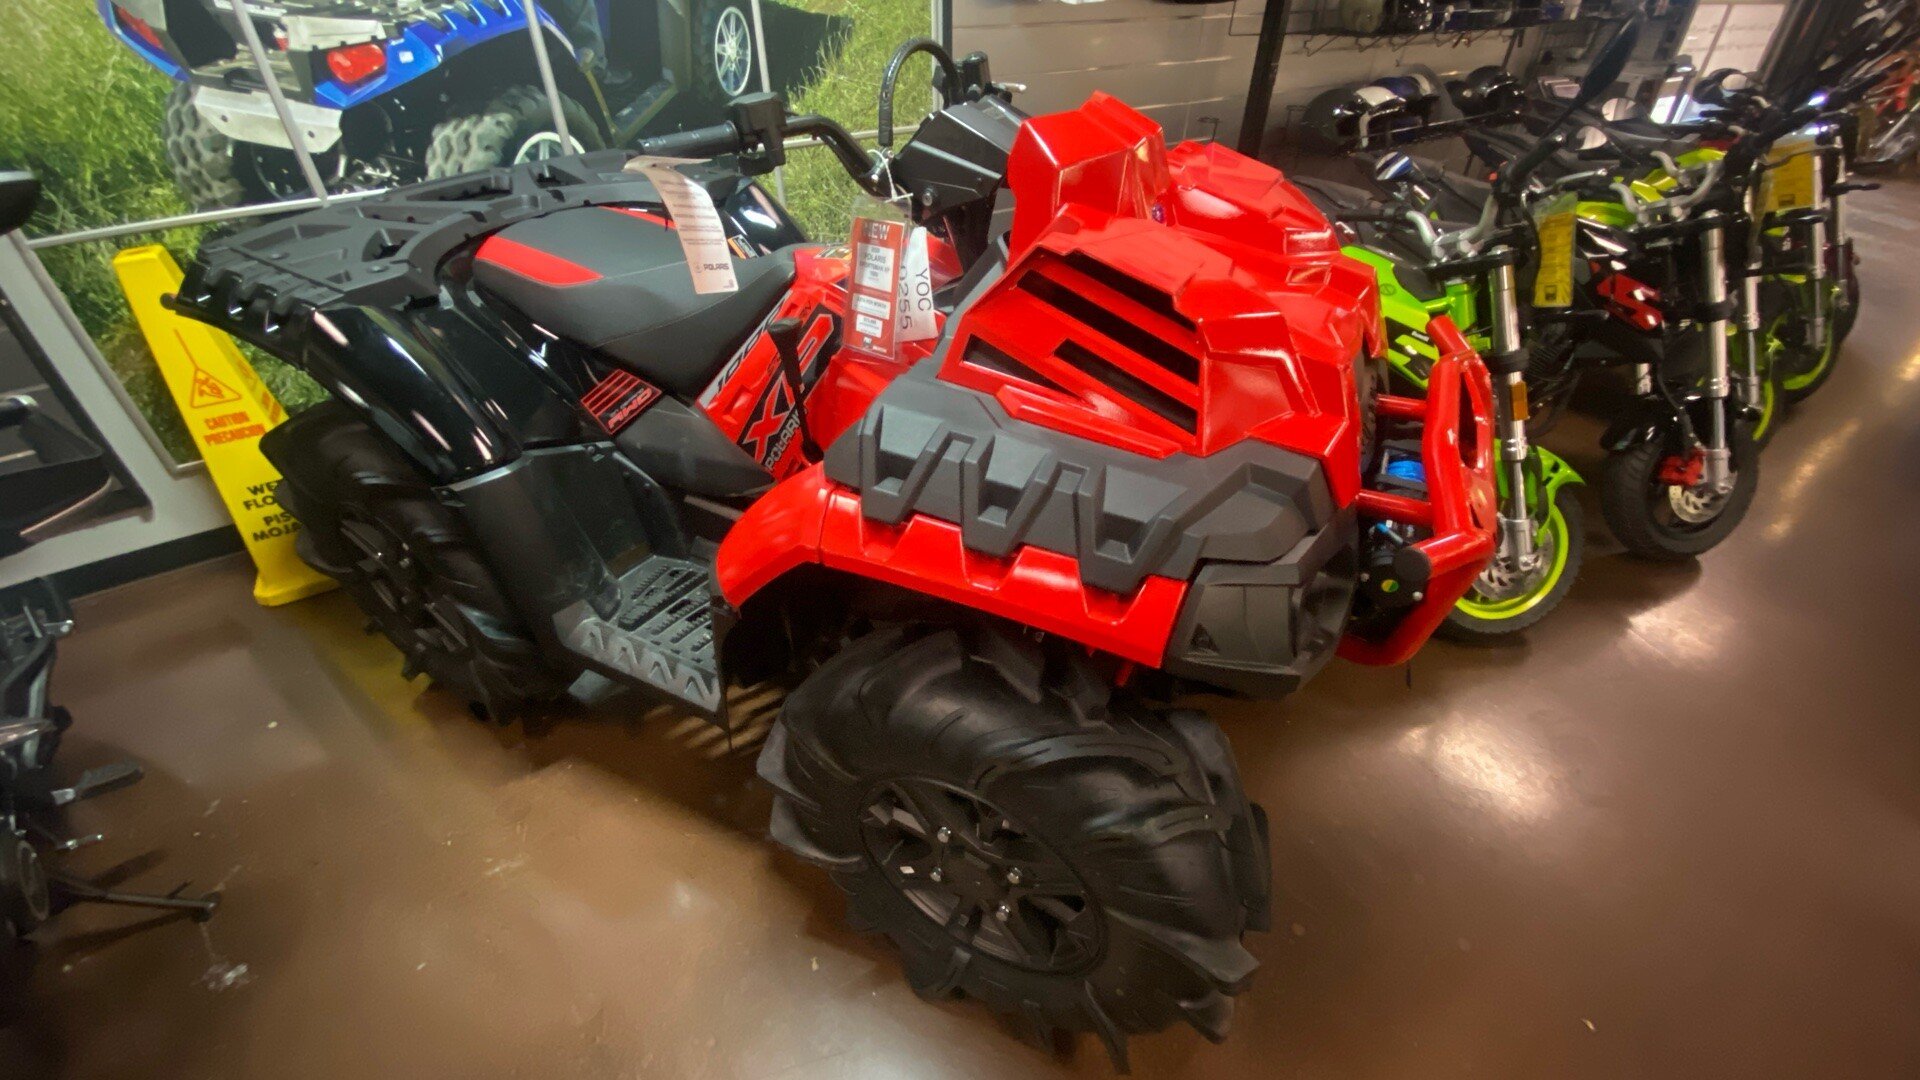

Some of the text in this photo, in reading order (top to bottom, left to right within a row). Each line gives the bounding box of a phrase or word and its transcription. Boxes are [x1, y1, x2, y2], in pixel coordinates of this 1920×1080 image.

[703, 263, 730, 271] POLARIS
[916, 268, 932, 311] YOC
[204, 411, 250, 430] CAUTION
[765, 407, 806, 472] POLARI
[247, 481, 279, 496] WE
[263, 511, 292, 526] PIS
